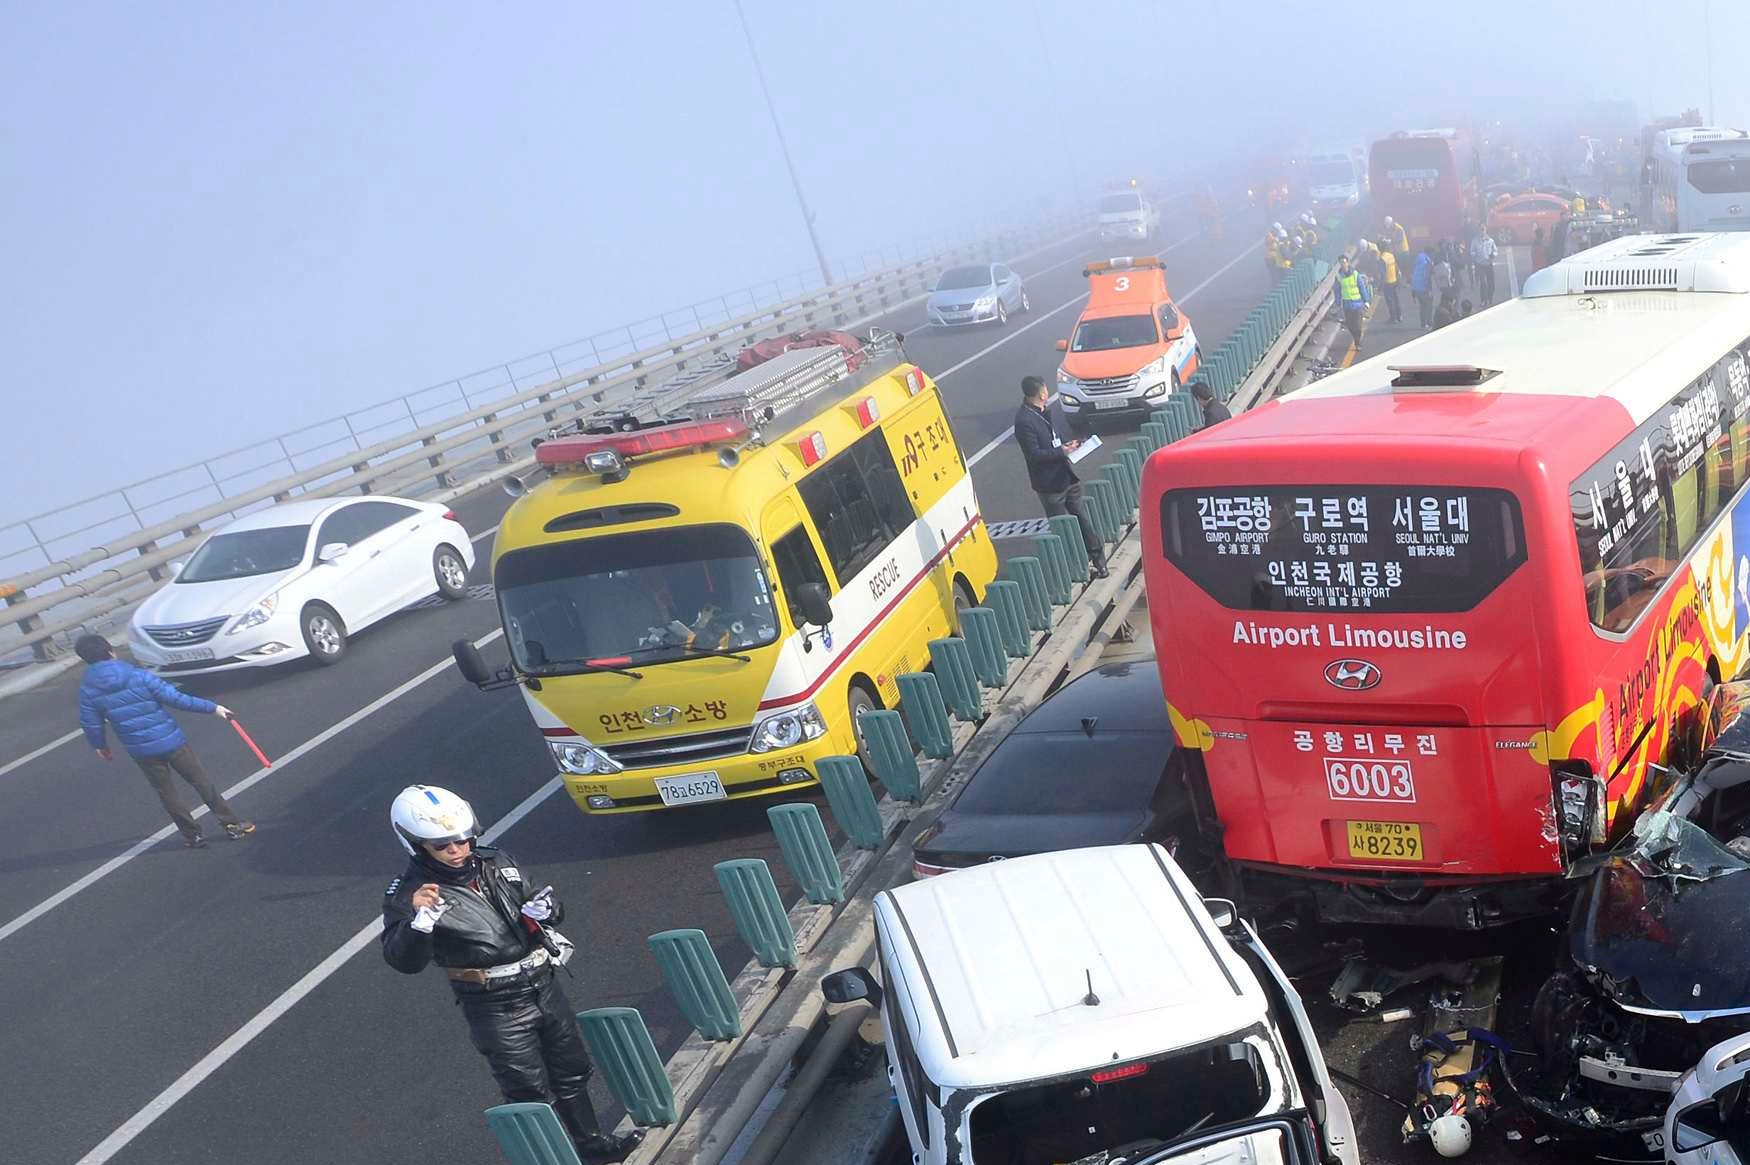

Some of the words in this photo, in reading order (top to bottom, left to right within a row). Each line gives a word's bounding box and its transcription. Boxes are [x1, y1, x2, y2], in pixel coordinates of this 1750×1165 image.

[1114, 276, 1130, 292] 3
[1197, 496, 1272, 531] 김포공항
[1295, 497, 1368, 531] 구로역
[1392, 497, 1469, 532] 서울대
[1205, 532, 1231, 543] GIMPO
[1235, 532, 1270, 543] AIRPORT
[1303, 532, 1327, 544] GURO
[1331, 532, 1368, 544] STATION
[1395, 533, 1420, 544] SEOUL
[1423, 533, 1448, 544] NAT'L
[1451, 533, 1470, 544] UNIV
[868, 557, 900, 601] RESCUE
[1268, 560, 1402, 587] 인천국제공항
[1284, 586, 1323, 597] INCHEON
[1326, 586, 1349, 598] INT'L
[1351, 587, 1391, 598] AIRPORT
[1233, 621, 1321, 650] Airport
[1328, 622, 1467, 650] Limousine
[1619, 640, 1661, 726] Airport
[1663, 576, 1712, 662] Limousine
[599, 709, 645, 735] 인천
[684, 700, 728, 724] 소방
[1293, 729, 1438, 756] 공항리무진
[1330, 762, 1412, 798] 6003
[1364, 822, 1383, 834] 서울
[1385, 823, 1403, 835] 70
